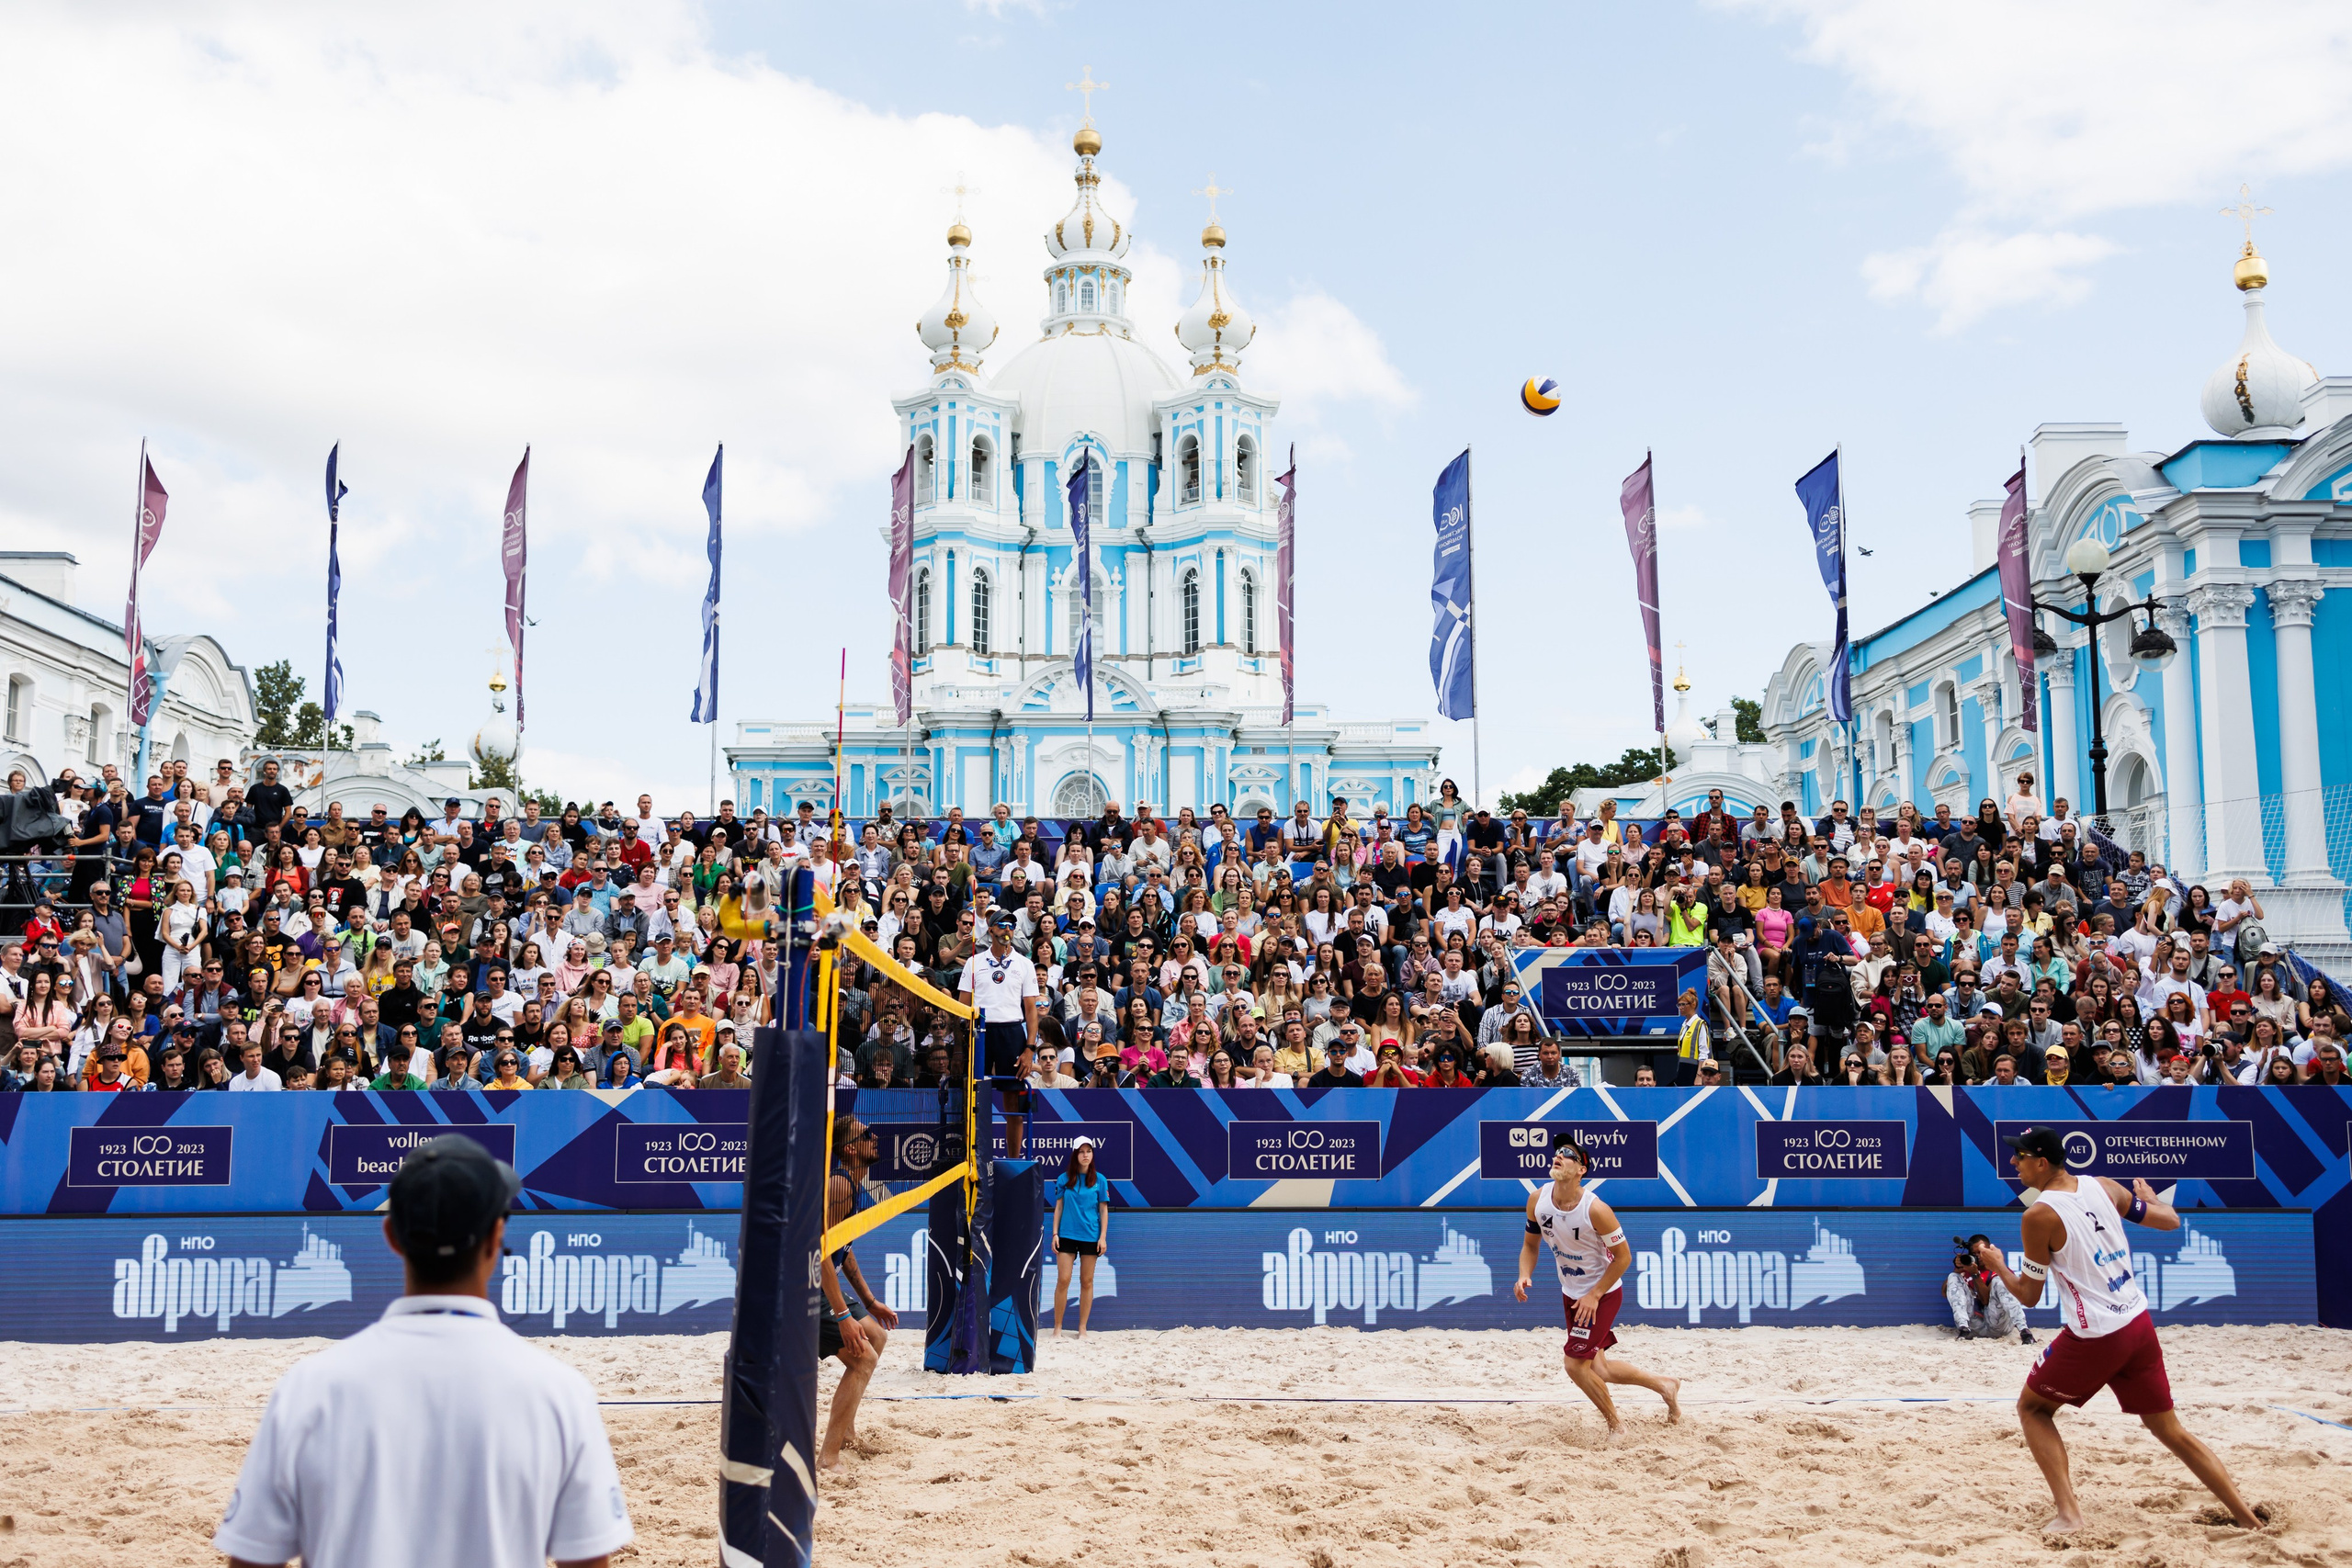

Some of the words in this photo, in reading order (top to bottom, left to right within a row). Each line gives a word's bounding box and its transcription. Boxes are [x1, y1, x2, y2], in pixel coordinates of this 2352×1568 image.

[1566, 982, 1589, 991] 1923
[1632, 981, 1656, 990] 2023
[1566, 995, 1657, 1010] СТОЛЕТИЕ
[645, 1142, 672, 1151] 1923
[720, 1141, 748, 1151] 2023
[1256, 1139, 1282, 1148] 1923
[1329, 1139, 1355, 1148] 2023
[1783, 1138, 1809, 1147] 1923
[1855, 1138, 1882, 1147] 2023
[2105, 1136, 2227, 1148] ОТЕЧЕСТВЕННОМУ
[99, 1145, 127, 1155] 1923
[176, 1144, 205, 1154] 2023
[2069, 1145, 2086, 1155] ЛЕТ
[644, 1156, 746, 1173] СТОЛЕТИЕ
[1256, 1155, 1355, 1170] СТОЛЕТИЕ
[1783, 1153, 1883, 1169] СТОЛЕТИЕ
[2107, 1152, 2188, 1165] ВОЛЕЙБОЛУ
[97, 1160, 204, 1177] СТОЛЕТИЕ
[2086, 1212, 2105, 1233] 2
[1325, 1230, 1358, 1244] НПО
[1572, 1227, 1579, 1240] 1
[1698, 1230, 1731, 1244] НПО
[181, 1235, 215, 1250] НПО
[567, 1234, 602, 1247] НПО
